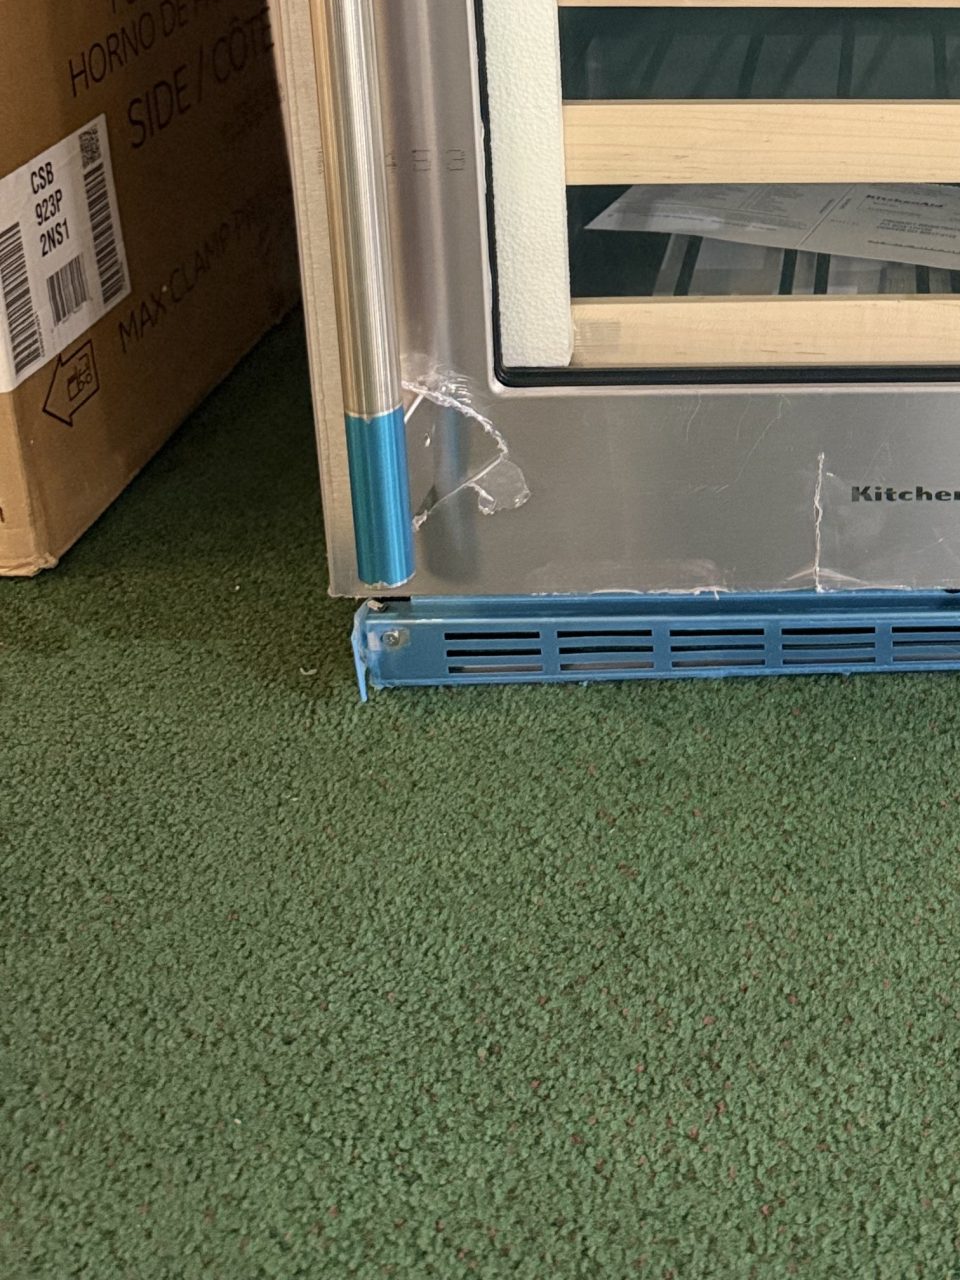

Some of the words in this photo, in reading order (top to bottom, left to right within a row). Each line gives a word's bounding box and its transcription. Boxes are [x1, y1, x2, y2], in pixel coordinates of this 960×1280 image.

[68, 12, 157, 98] HORNO
[127, 65, 192, 149] SIDE
[30, 160, 54, 195] CSB
[35, 188, 63, 226] 923P
[39, 218, 70, 258] 2NS1
[118, 284, 168, 355] MAX
